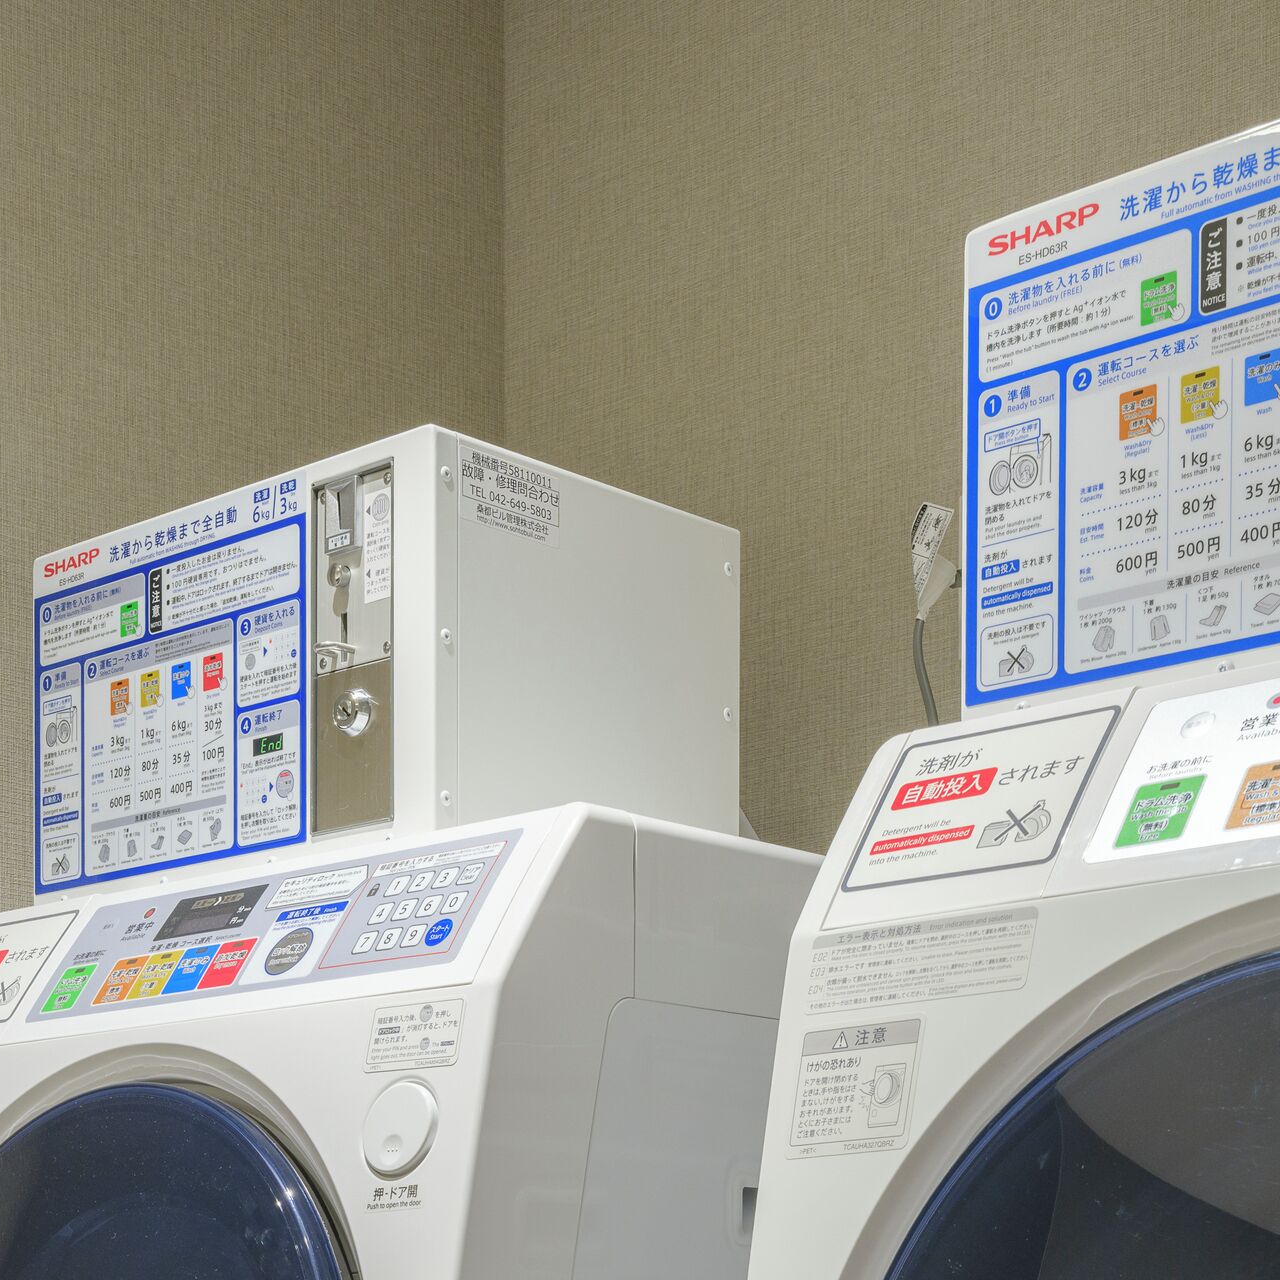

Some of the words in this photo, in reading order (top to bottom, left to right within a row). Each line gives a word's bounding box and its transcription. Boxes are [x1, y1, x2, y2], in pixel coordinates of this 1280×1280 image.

[1161, 207, 1174, 220] Full
[1176, 195, 1212, 215] automatic
[1214, 188, 1232, 202] from
[1234, 175, 1271, 196] WASHING
[988, 200, 1099, 258] SHARP
[1018, 240, 1067, 266] ES-HD63R
[1205, 225, 1222, 292] ご注意
[1008, 258, 1115, 307] 洗濯物を入れる前に
[1008, 301, 1031, 316] Before
[1032, 292, 1058, 310] laundry
[1060, 284, 1082, 301] (FREE)
[1202, 292, 1225, 307] NOTICE
[1097, 333, 1199, 377] 運転コースを選ぶ
[1098, 373, 1119, 387] Select
[1121, 365, 1146, 380] Course
[1007, 383, 1031, 404] 準備
[1007, 399, 1028, 414] Ready
[1030, 397, 1036, 406] to
[1038, 392, 1054, 404] Start
[471, 450, 552, 489] 機械番号58110011
[462, 462, 559, 508] 故障・修理問合わせ
[469, 484, 487, 500] TEL
[489, 490, 552, 521] 042-649-5803
[984, 489, 1051, 515] 洗濯物を入れてドアを
[1080, 491, 1102, 504] Capacity
[984, 512, 1004, 525] 閉める
[109, 504, 237, 563] 洗濯から乾燥まで全自動
[43, 546, 99, 578] SHARP
[984, 548, 1007, 564] 洗剤が
[984, 561, 1016, 578] 自動投入
[1021, 553, 1053, 569] されます
[1167, 569, 1218, 590] 洗濯量の目安
[1224, 560, 1260, 576] Reference
[982, 580, 1012, 595] Detergent
[983, 590, 1021, 607] automatically
[1022, 583, 1050, 598] dispensed
[254, 604, 295, 626] 硬貨を入れる
[987, 620, 1046, 640] 洗剤の投入は不要です
[99, 646, 149, 670] 運転コースを選ぶ
[255, 708, 282, 726] 運転終了
[261, 734, 282, 753] End
[916, 748, 984, 777] 洗剤が
[902, 773, 984, 805] 自動投入
[998, 755, 1085, 786] されます
[927, 828, 970, 844] dispensed
[393, 881, 400, 893] 1
[415, 876, 425, 888] 2
[441, 872, 450, 884] 3
[399, 903, 408, 915] 5
[424, 901, 433, 913] 6
[448, 896, 458, 908] 0
[376, 908, 385, 919] 4
[384, 933, 393, 945] 8
[408, 929, 418, 942] 9
[429, 923, 450, 934] スタート
[362, 937, 371, 949] 7
[855, 1026, 888, 1046] 注意
[807, 1057, 862, 1073] けがの恐れあり
